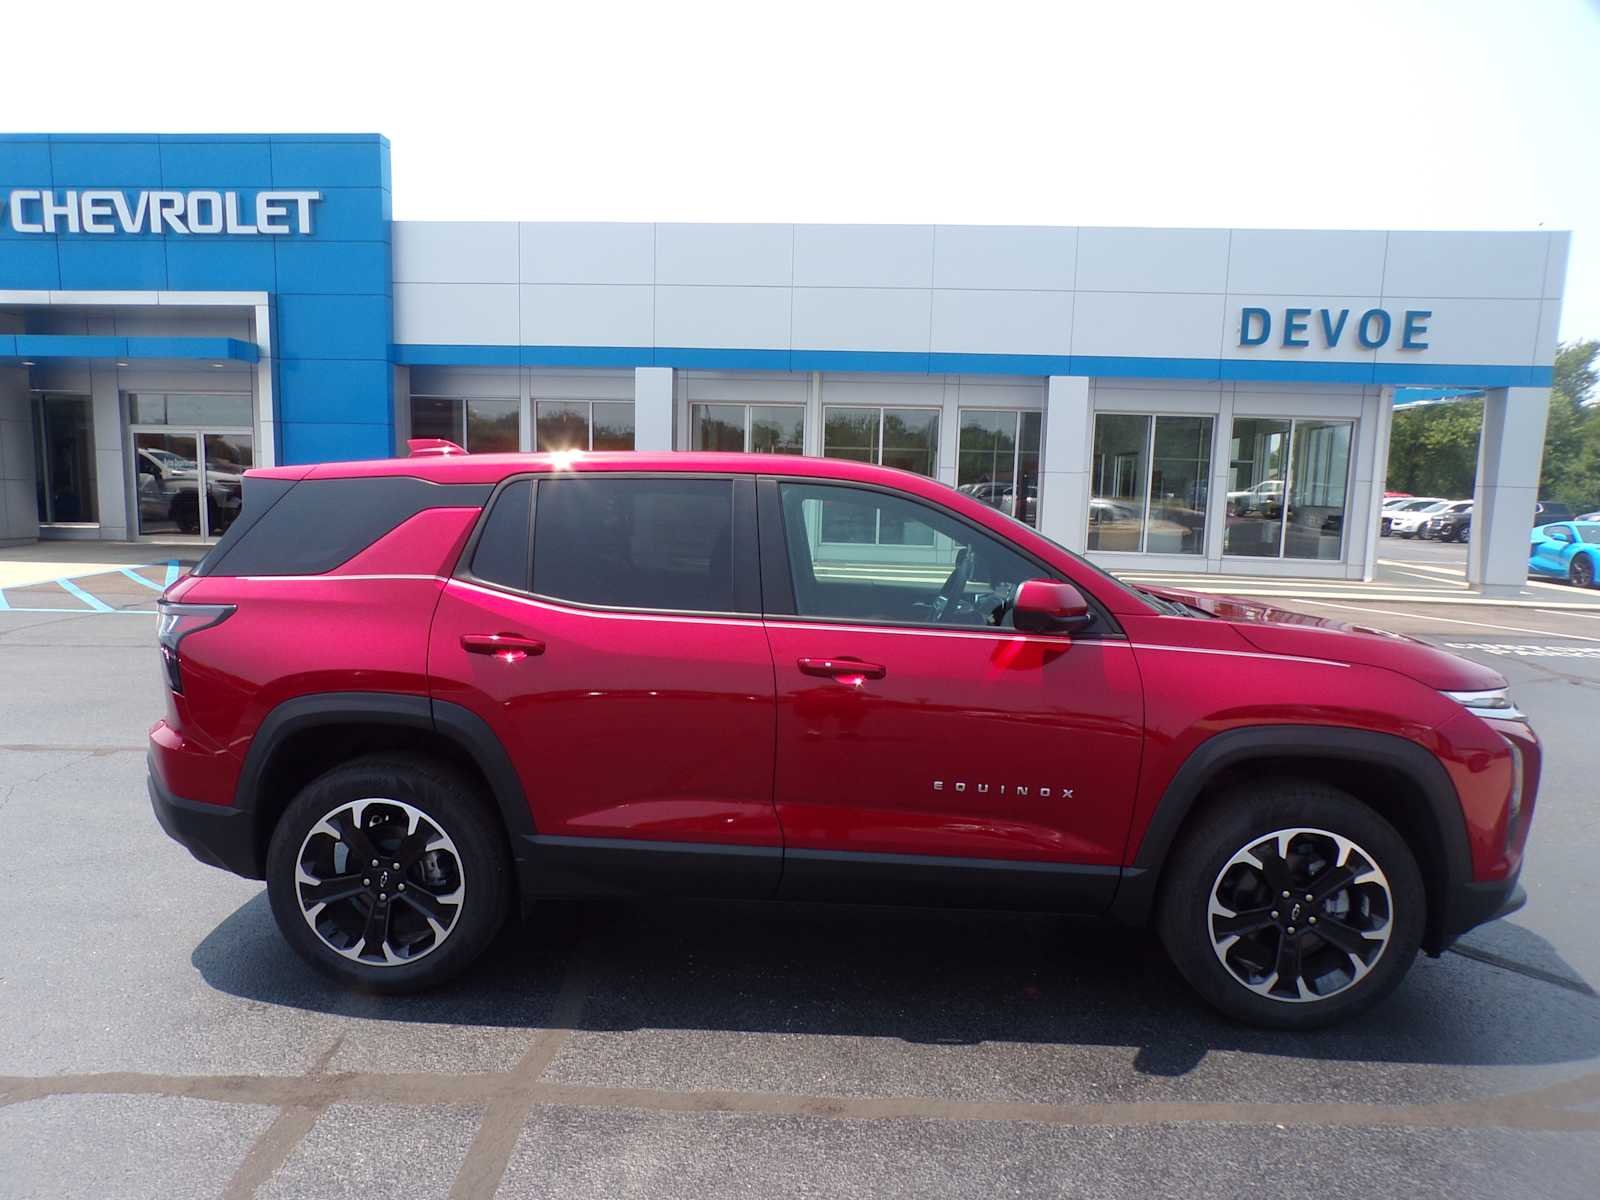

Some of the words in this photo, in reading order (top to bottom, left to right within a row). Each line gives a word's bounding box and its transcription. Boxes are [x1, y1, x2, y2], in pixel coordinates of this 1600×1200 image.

[10, 190, 320, 234] CHEVROLET
[1239, 307, 1432, 350] DEVOE
[933, 780, 1074, 798] EQUINOX
